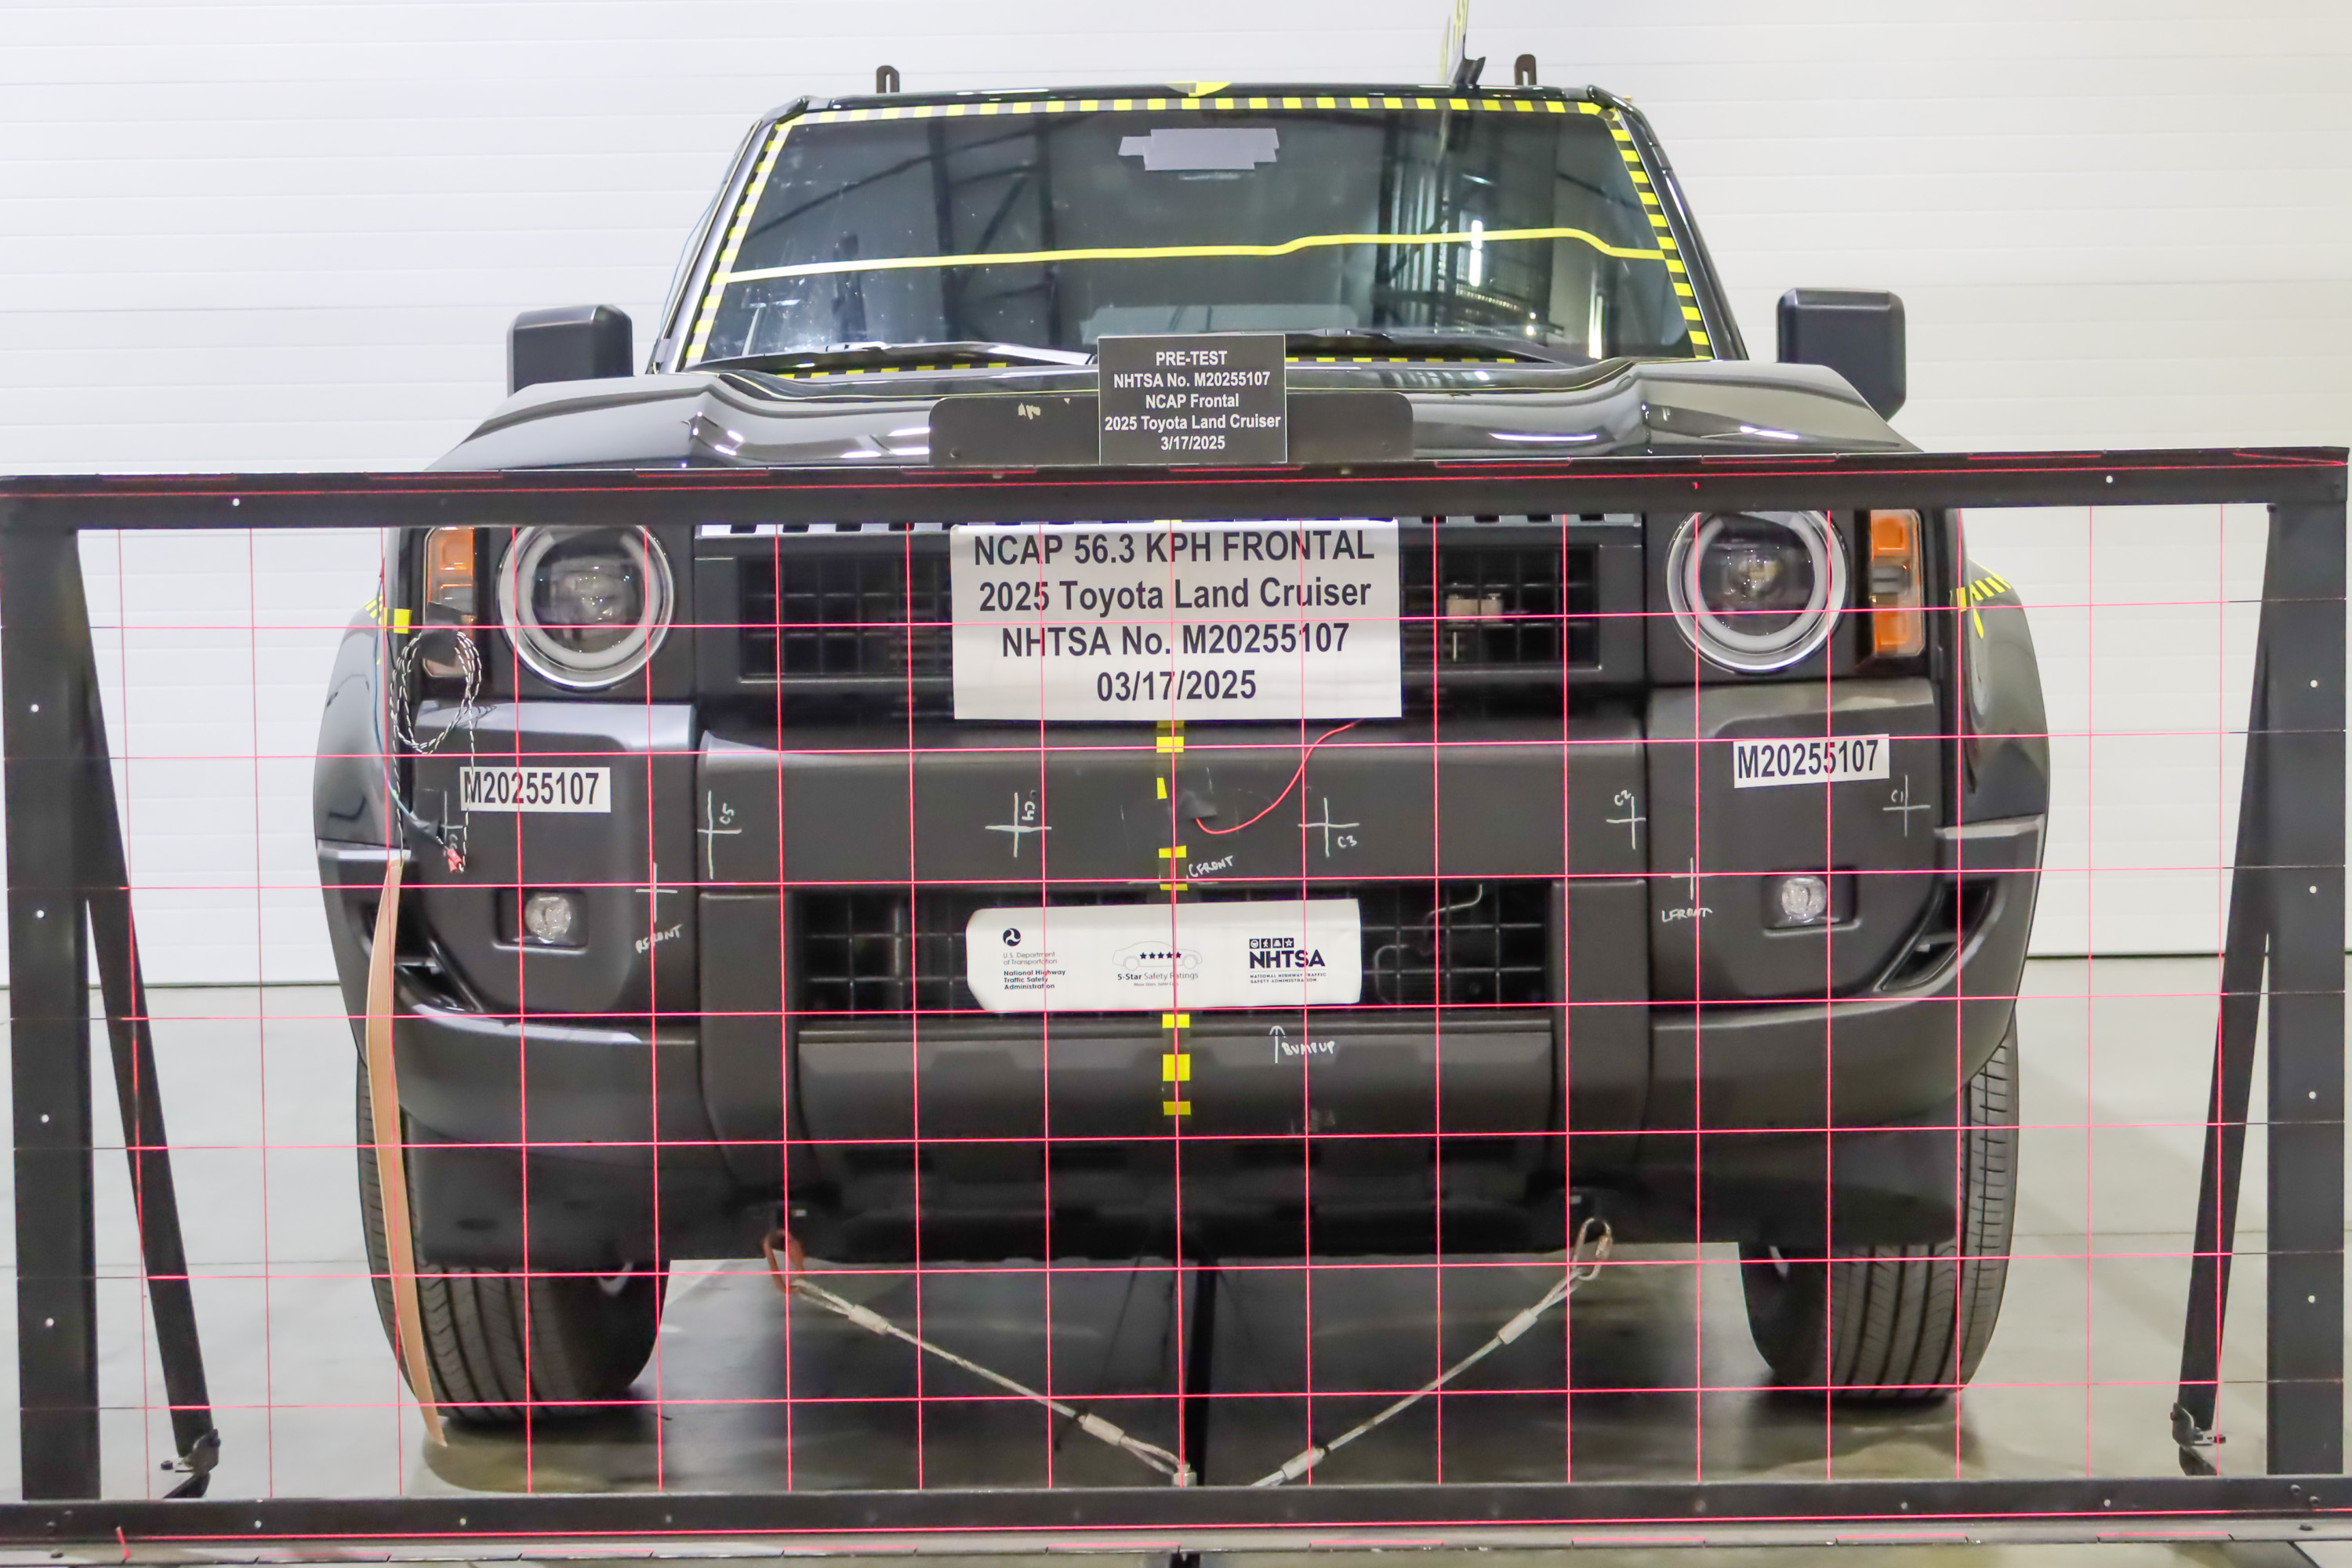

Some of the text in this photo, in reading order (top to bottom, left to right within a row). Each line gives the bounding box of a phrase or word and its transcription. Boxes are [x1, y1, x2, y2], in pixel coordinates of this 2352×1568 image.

[1156, 350, 1228, 366] PRE-TEST
[1113, 372, 1271, 388] NHTSA No. M20255107
[1145, 393, 1240, 408] NCAP Frontal
[1105, 413, 1282, 433] 2025 Toyota Land Cruiser
[1160, 435, 1225, 451] 3/17/2025
[974, 529, 1375, 565] NCAP 56.3 KPH FRONTAL
[979, 576, 1372, 618] 2025 Toyota Land Cruiser
[1002, 622, 1349, 657] NHTSA No. M20255107
[1097, 670, 1257, 701] 03/17/2025
[1737, 739, 1879, 779] M20255107
[463, 771, 600, 806] M20255107
[1337, 834, 1359, 849] C3
[1249, 949, 1326, 969] NHTSA
[1144, 972, 1168, 981] Safety
